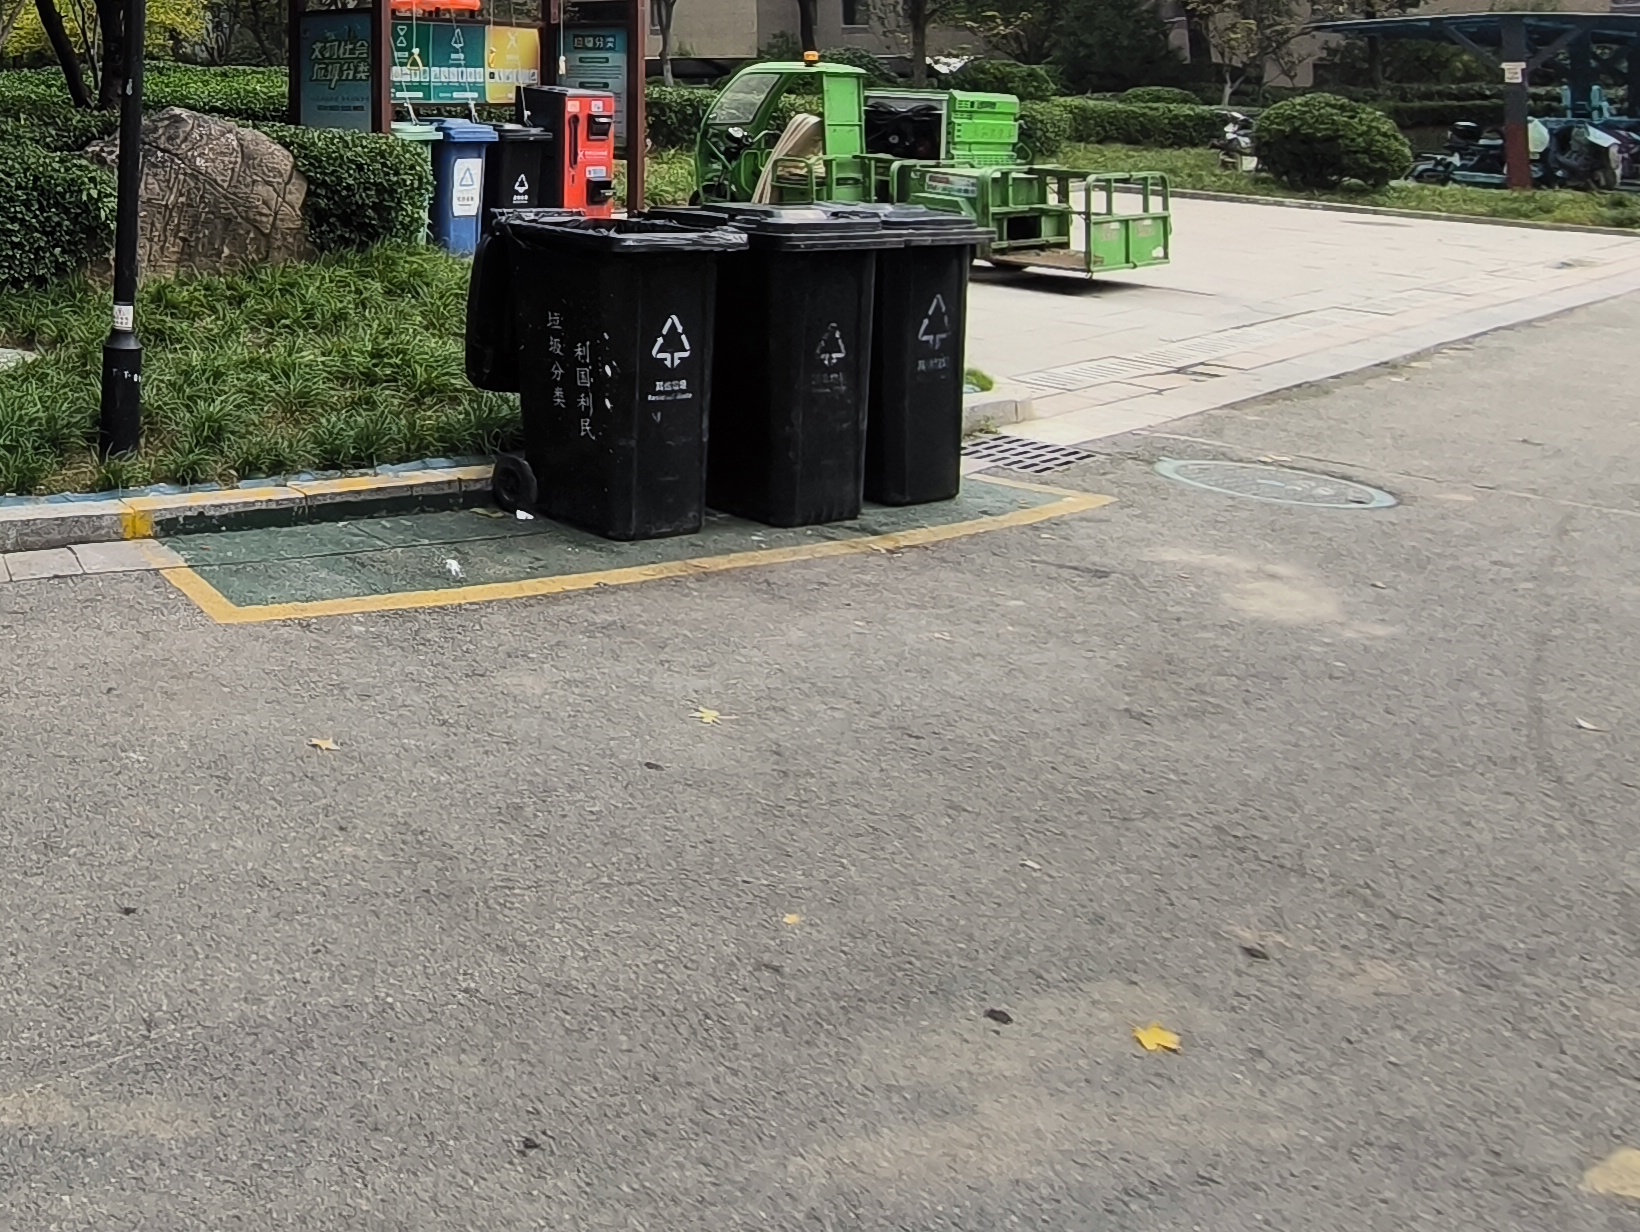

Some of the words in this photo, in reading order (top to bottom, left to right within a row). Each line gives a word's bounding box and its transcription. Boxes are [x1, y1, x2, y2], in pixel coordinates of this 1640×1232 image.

[546, 311, 567, 408] 垃圾分类
[573, 340, 596, 441] 利国利民
